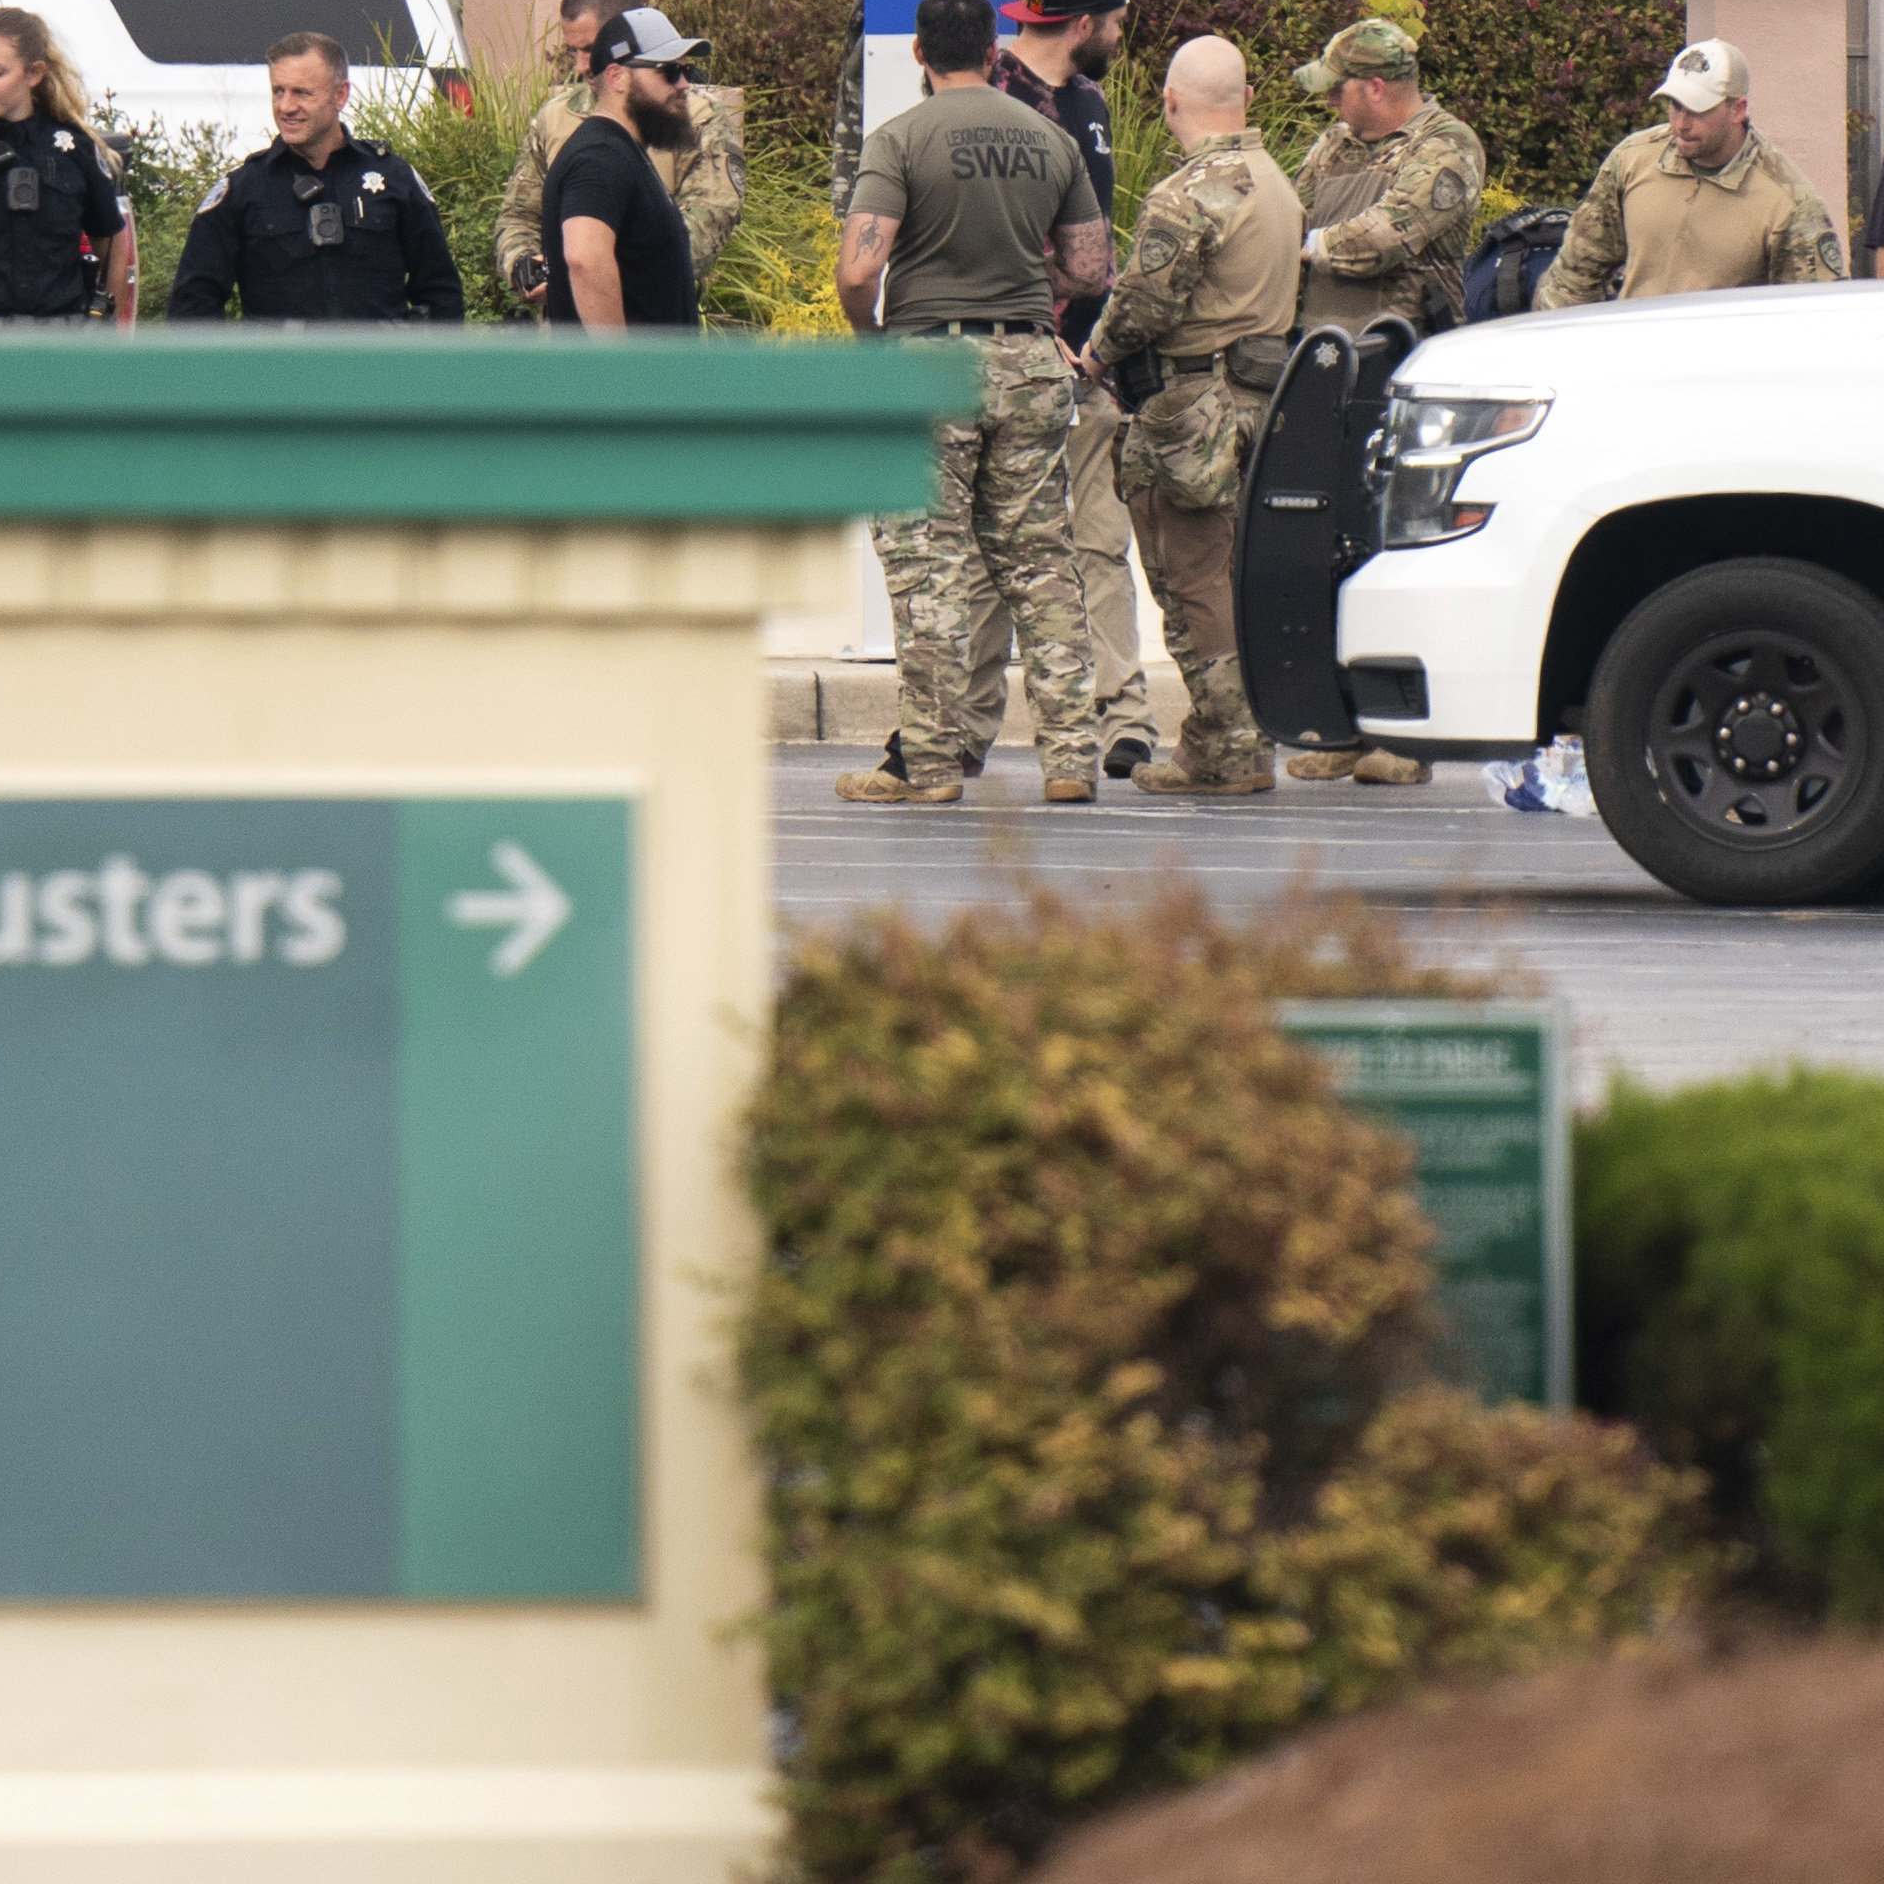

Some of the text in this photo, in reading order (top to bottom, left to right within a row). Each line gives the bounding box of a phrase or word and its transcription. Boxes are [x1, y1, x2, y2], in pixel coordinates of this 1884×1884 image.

[946, 126, 1048, 147] LEXINGTON COUNTY
[950, 145, 1051, 182] SWAT
